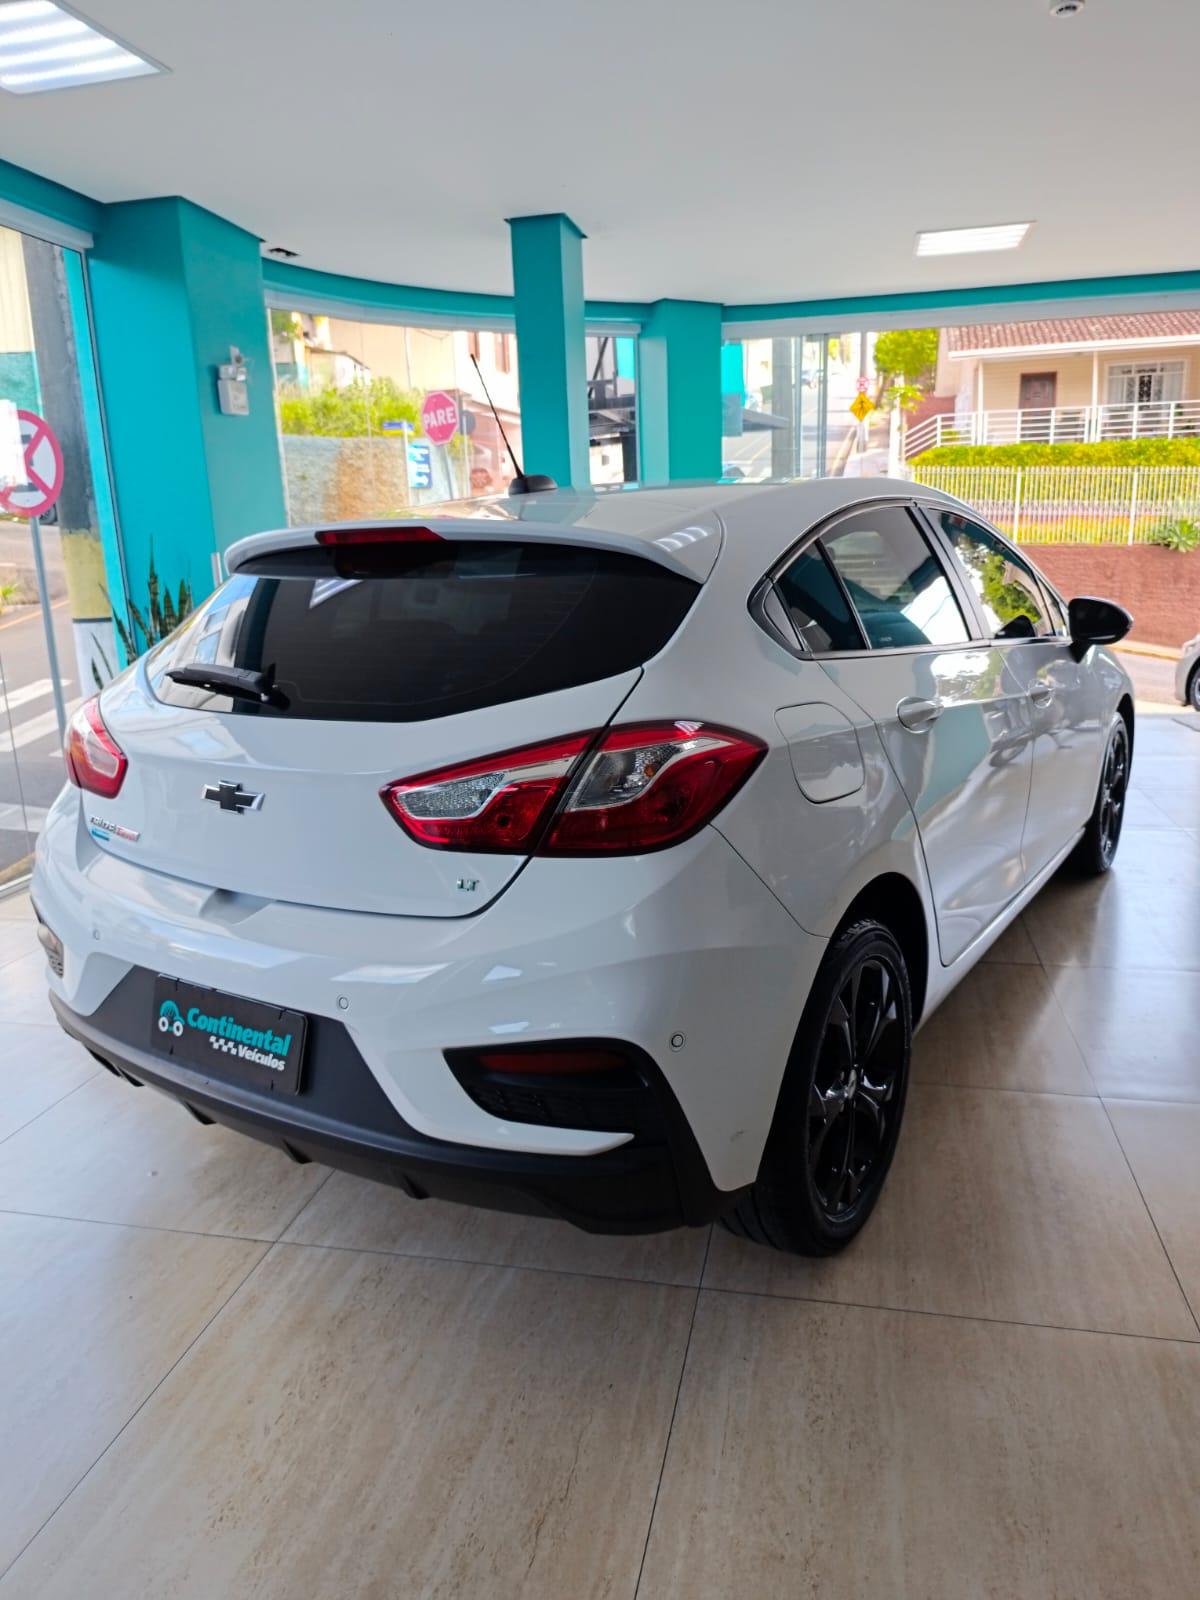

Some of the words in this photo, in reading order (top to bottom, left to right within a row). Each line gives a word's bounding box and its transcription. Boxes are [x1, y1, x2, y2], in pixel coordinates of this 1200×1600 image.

[423, 406, 456, 428] PARE
[187, 1007, 292, 1056] Continental
[238, 1044, 285, 1071] Veículos
